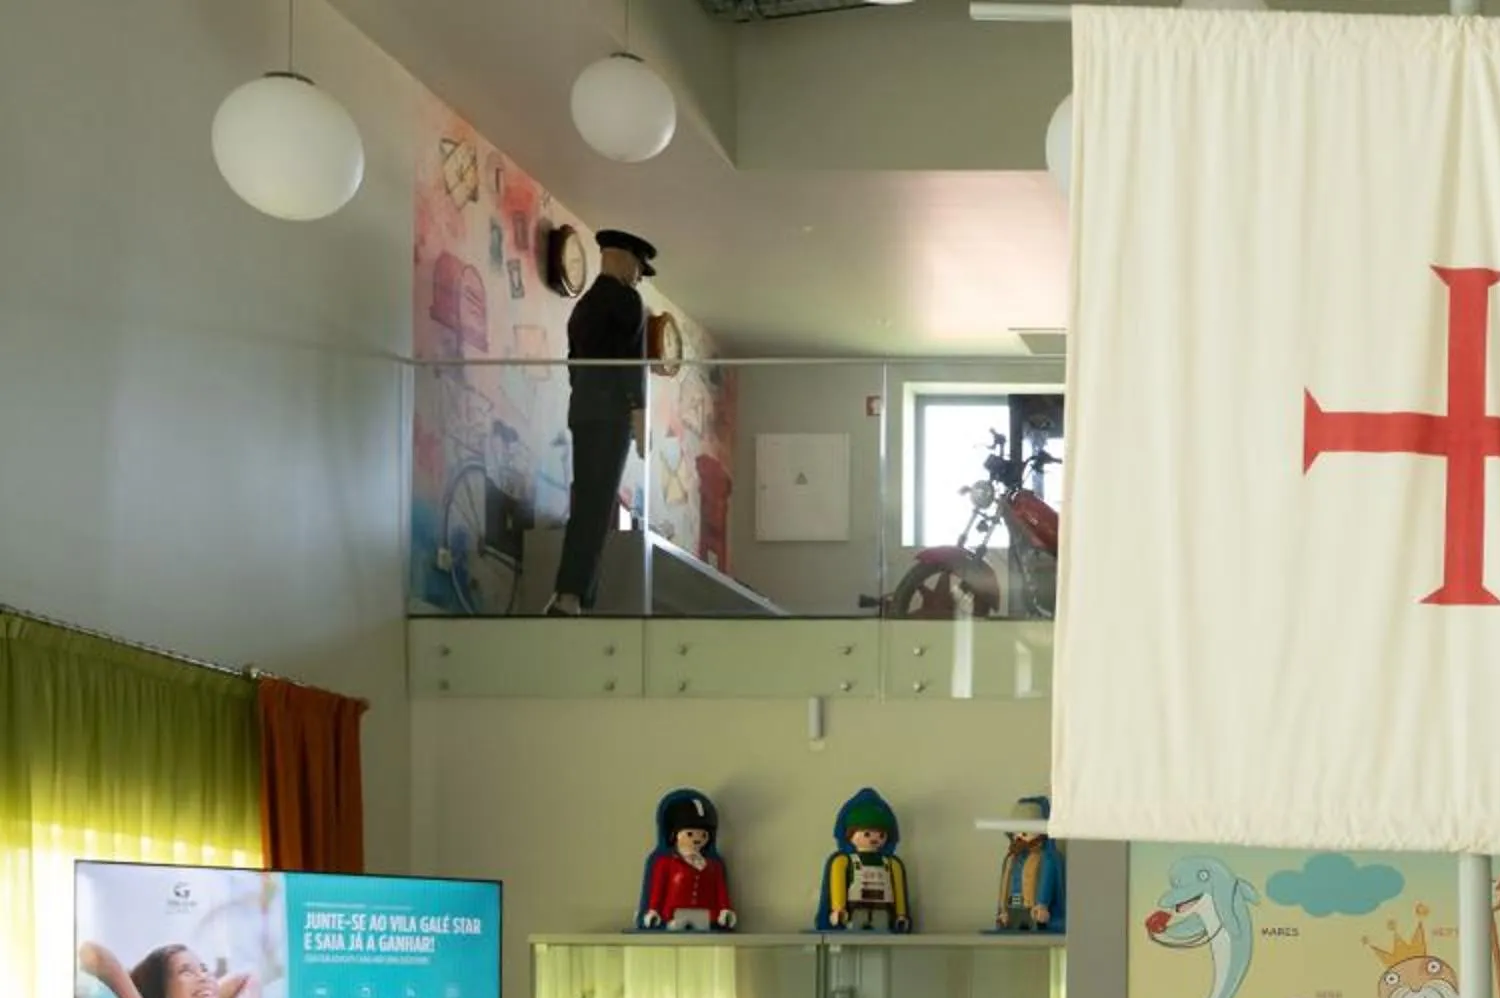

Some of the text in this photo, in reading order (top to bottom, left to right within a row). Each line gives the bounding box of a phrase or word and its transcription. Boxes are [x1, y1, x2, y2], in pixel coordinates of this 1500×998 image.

[304, 912, 481, 935] JUNTE-SE AO VILA GALÉ STAR
[304, 931, 435, 953] E SAIA JÁ A GANHAR!
